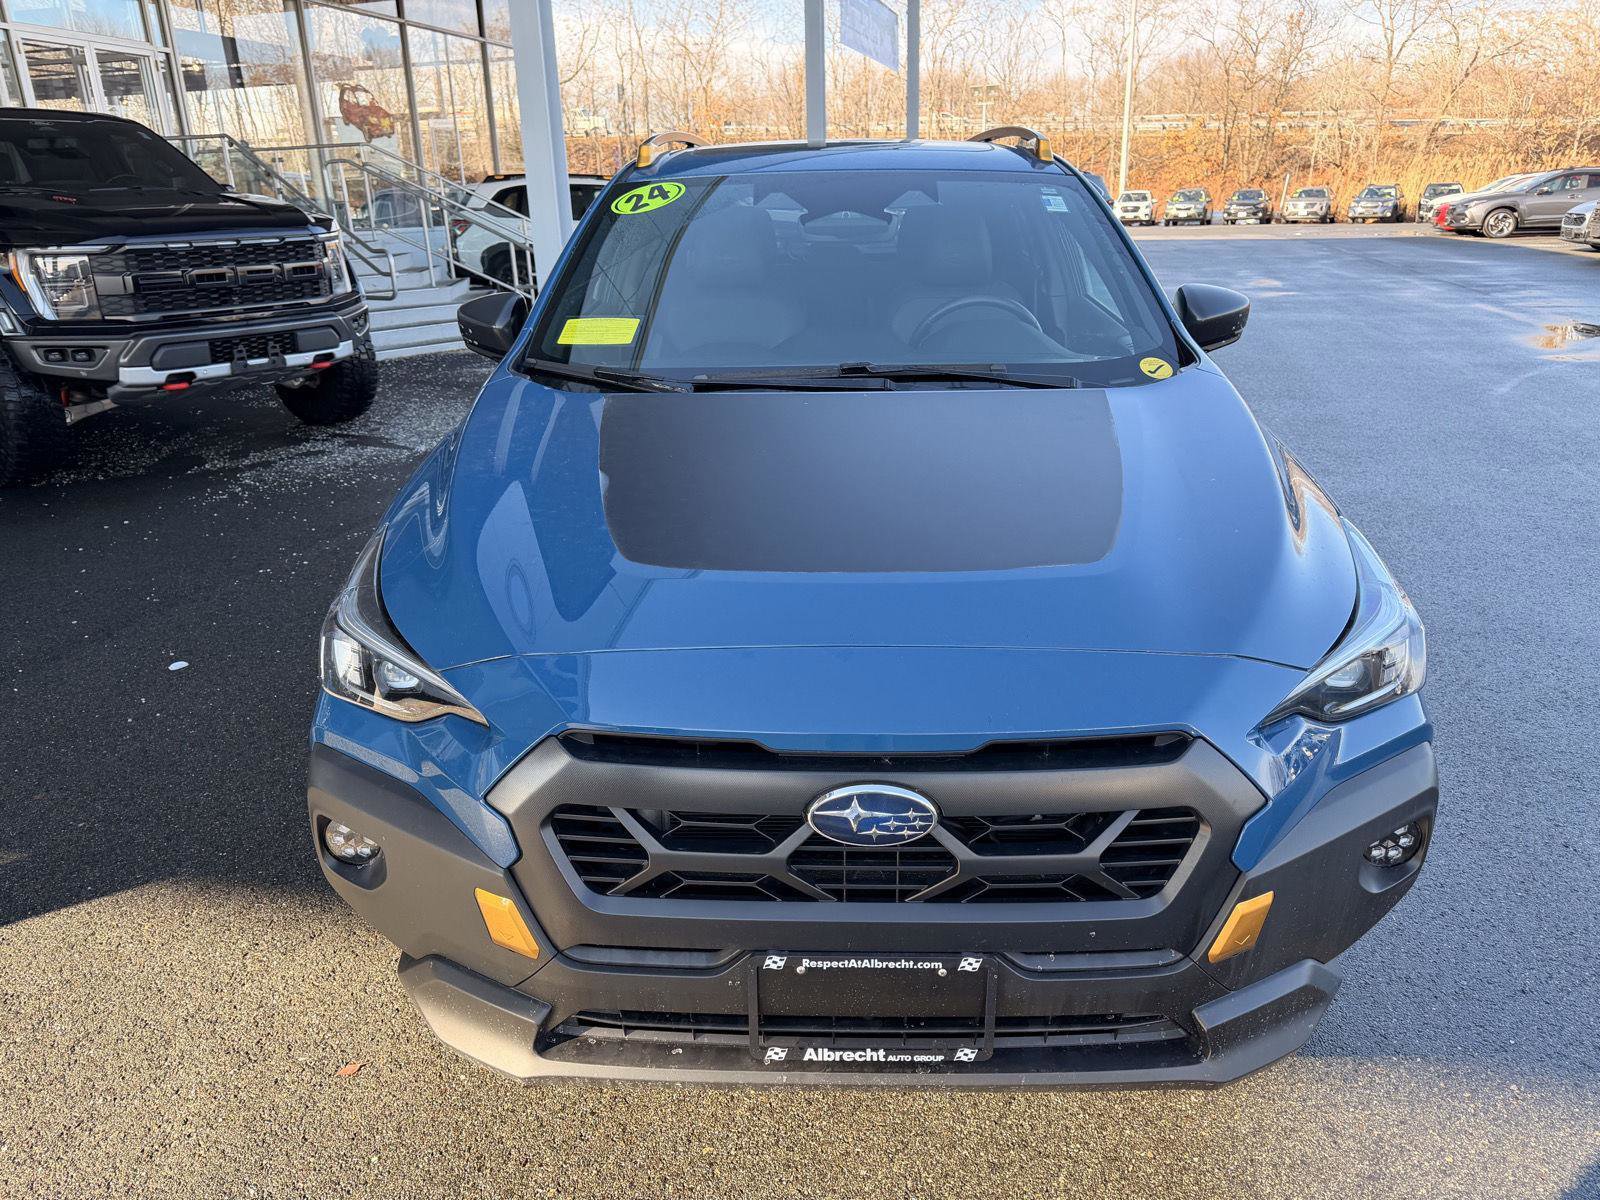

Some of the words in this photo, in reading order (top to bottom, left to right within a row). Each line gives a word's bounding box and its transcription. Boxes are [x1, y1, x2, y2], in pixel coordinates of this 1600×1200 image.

[625, 185, 670, 211] 24
[802, 958, 942, 970] RespectAtAlbrecht.com
[803, 1048, 886, 1062] Albrecht
